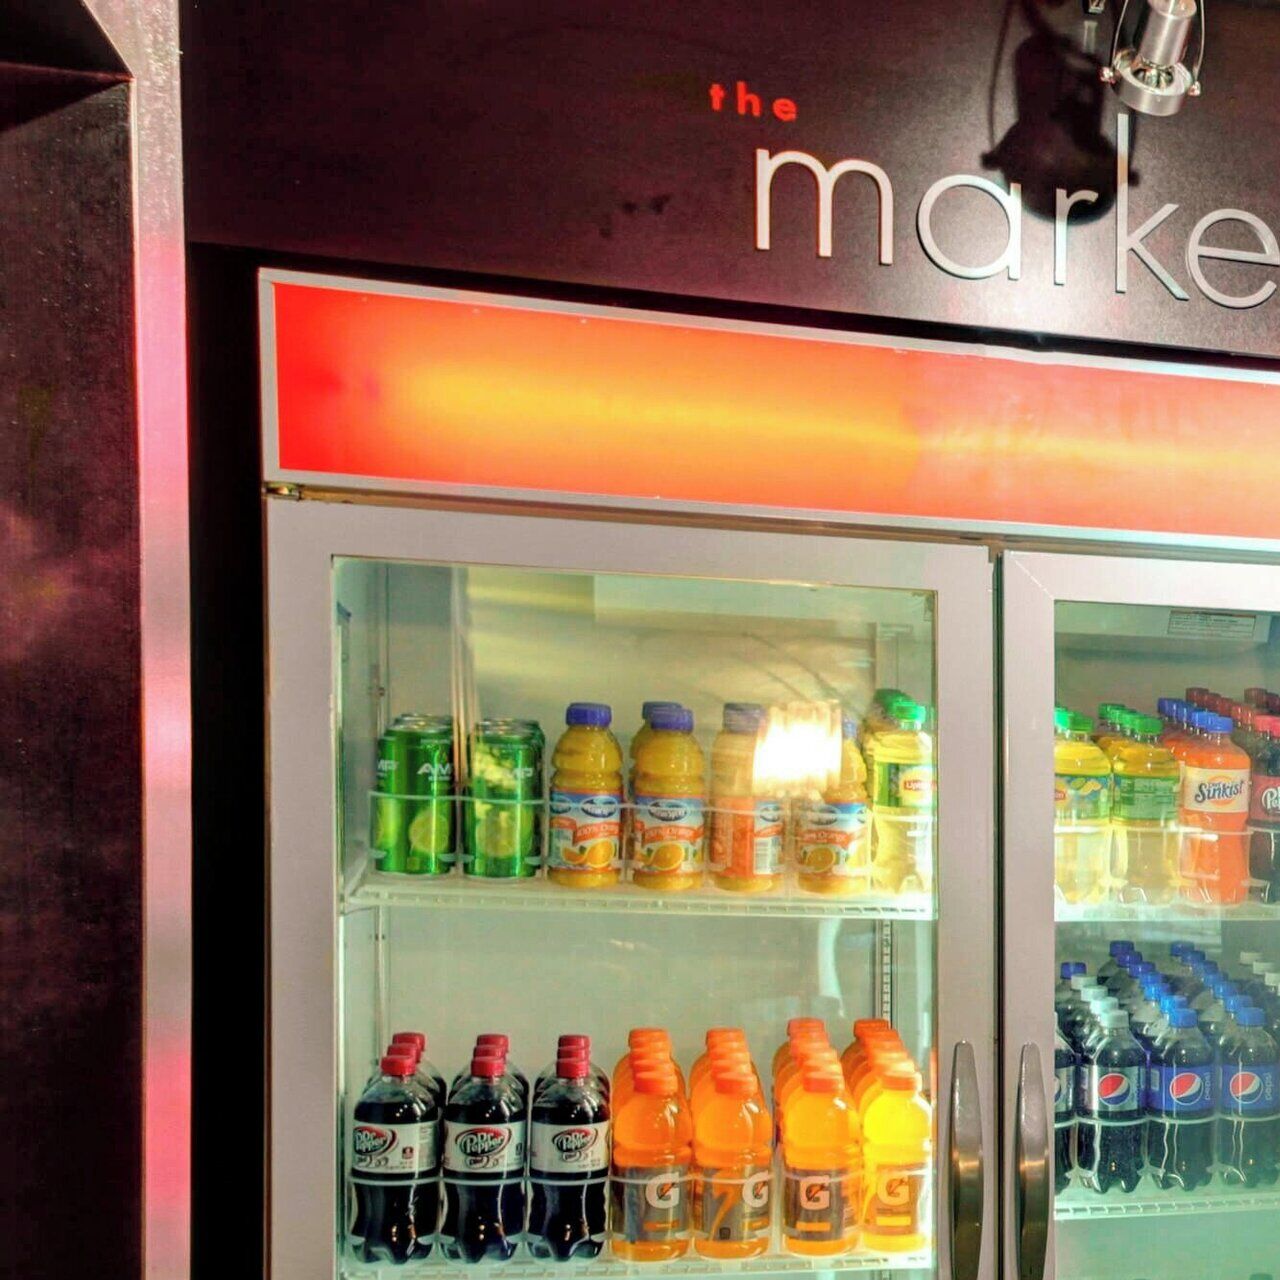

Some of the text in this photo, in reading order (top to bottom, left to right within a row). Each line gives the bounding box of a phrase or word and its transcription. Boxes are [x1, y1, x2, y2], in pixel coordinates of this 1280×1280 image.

[709, 81, 797, 122] the
[417, 762, 450, 774] AM
[645, 1174, 680, 1208] G
[800, 1175, 830, 1210] G
